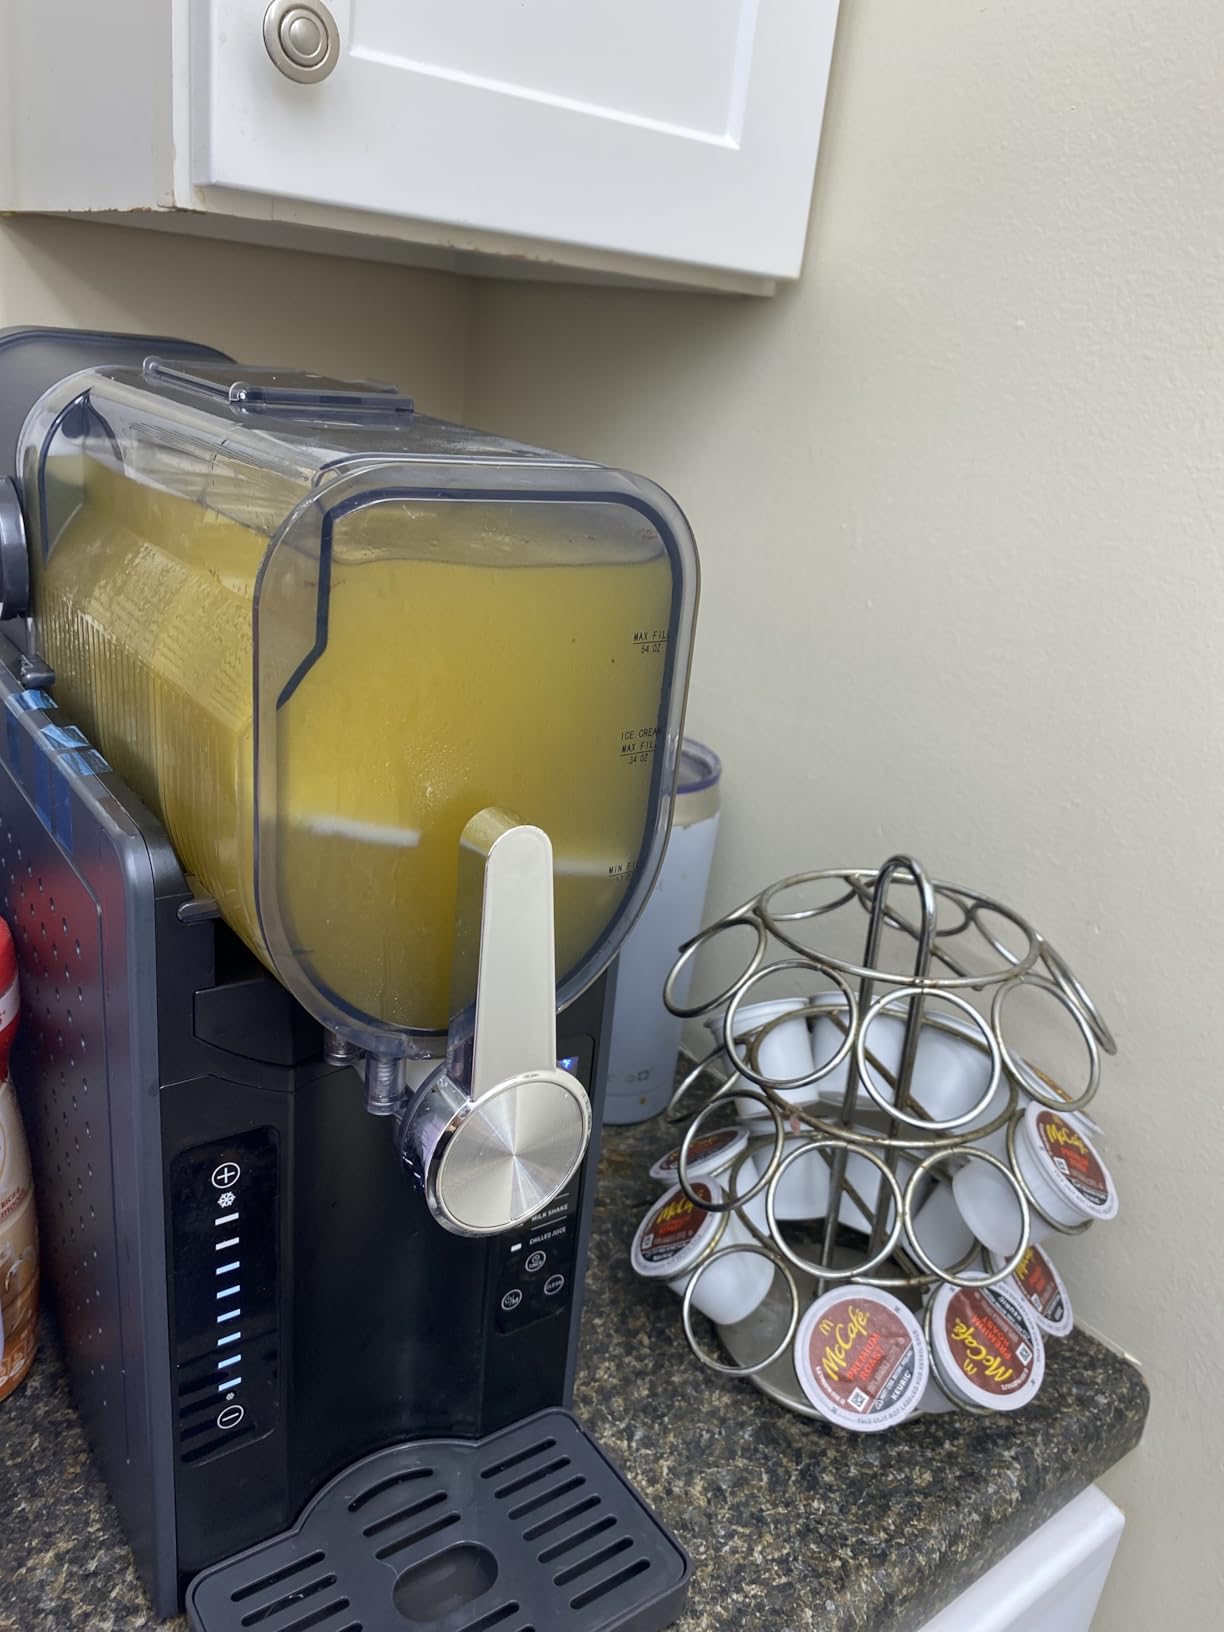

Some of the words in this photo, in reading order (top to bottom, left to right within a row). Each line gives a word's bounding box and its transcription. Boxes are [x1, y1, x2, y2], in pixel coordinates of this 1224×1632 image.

[633, 631, 649, 641] MAX
[640, 643, 649, 653] 54
[652, 643, 661, 652] OZ
[621, 730, 635, 740] ICE
[621, 743, 636, 753] MAX
[639, 753, 649, 762] OZ
[608, 863, 623, 875] MIN
[531, 1210, 547, 1222] MILK
[547, 1203, 569, 1216] SHAKE
[551, 1226, 567, 1237] JUICE
[969, 1314, 1011, 1360] PREMIUM
[981, 1315, 1009, 1346] ROAST
[822, 1305, 869, 1381] McCafé
[951, 1319, 1014, 1381] McCafé
[847, 1331, 881, 1380] PREMIUM
[859, 1344, 885, 1381] ROAST
